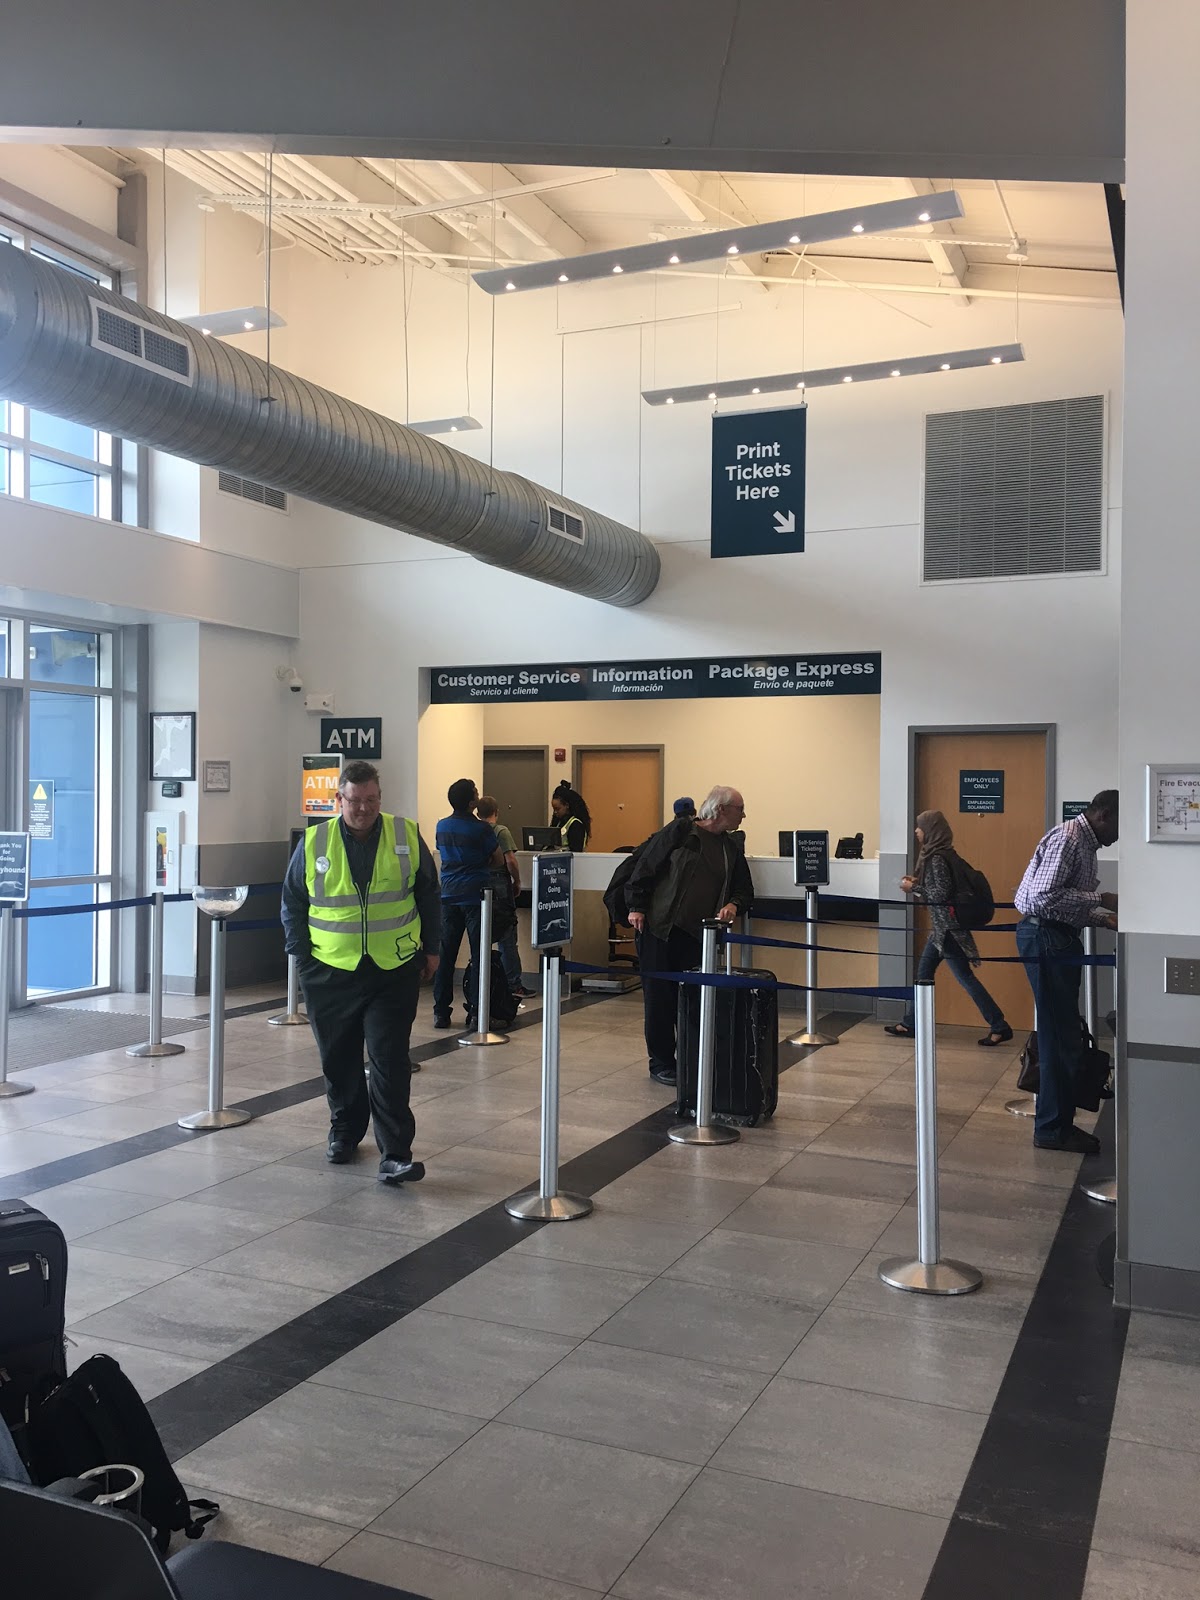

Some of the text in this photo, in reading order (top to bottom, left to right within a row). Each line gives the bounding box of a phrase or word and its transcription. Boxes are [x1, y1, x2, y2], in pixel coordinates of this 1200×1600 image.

[737, 442, 780, 460] Print
[725, 462, 791, 480] Tickets
[736, 485, 780, 500] Here
[592, 667, 693, 682] Information
[708, 661, 875, 680] Package Express
[437, 670, 581, 687] Customer Service
[753, 679, 834, 690] Envío de paquete
[470, 686, 539, 696] Servicio al cliente
[612, 684, 663, 693] Información
[327, 728, 374, 748] ATM
[305, 776, 338, 789] ATM
[543, 868, 557, 876] Thank
[538, 898, 569, 911] Greyhound
